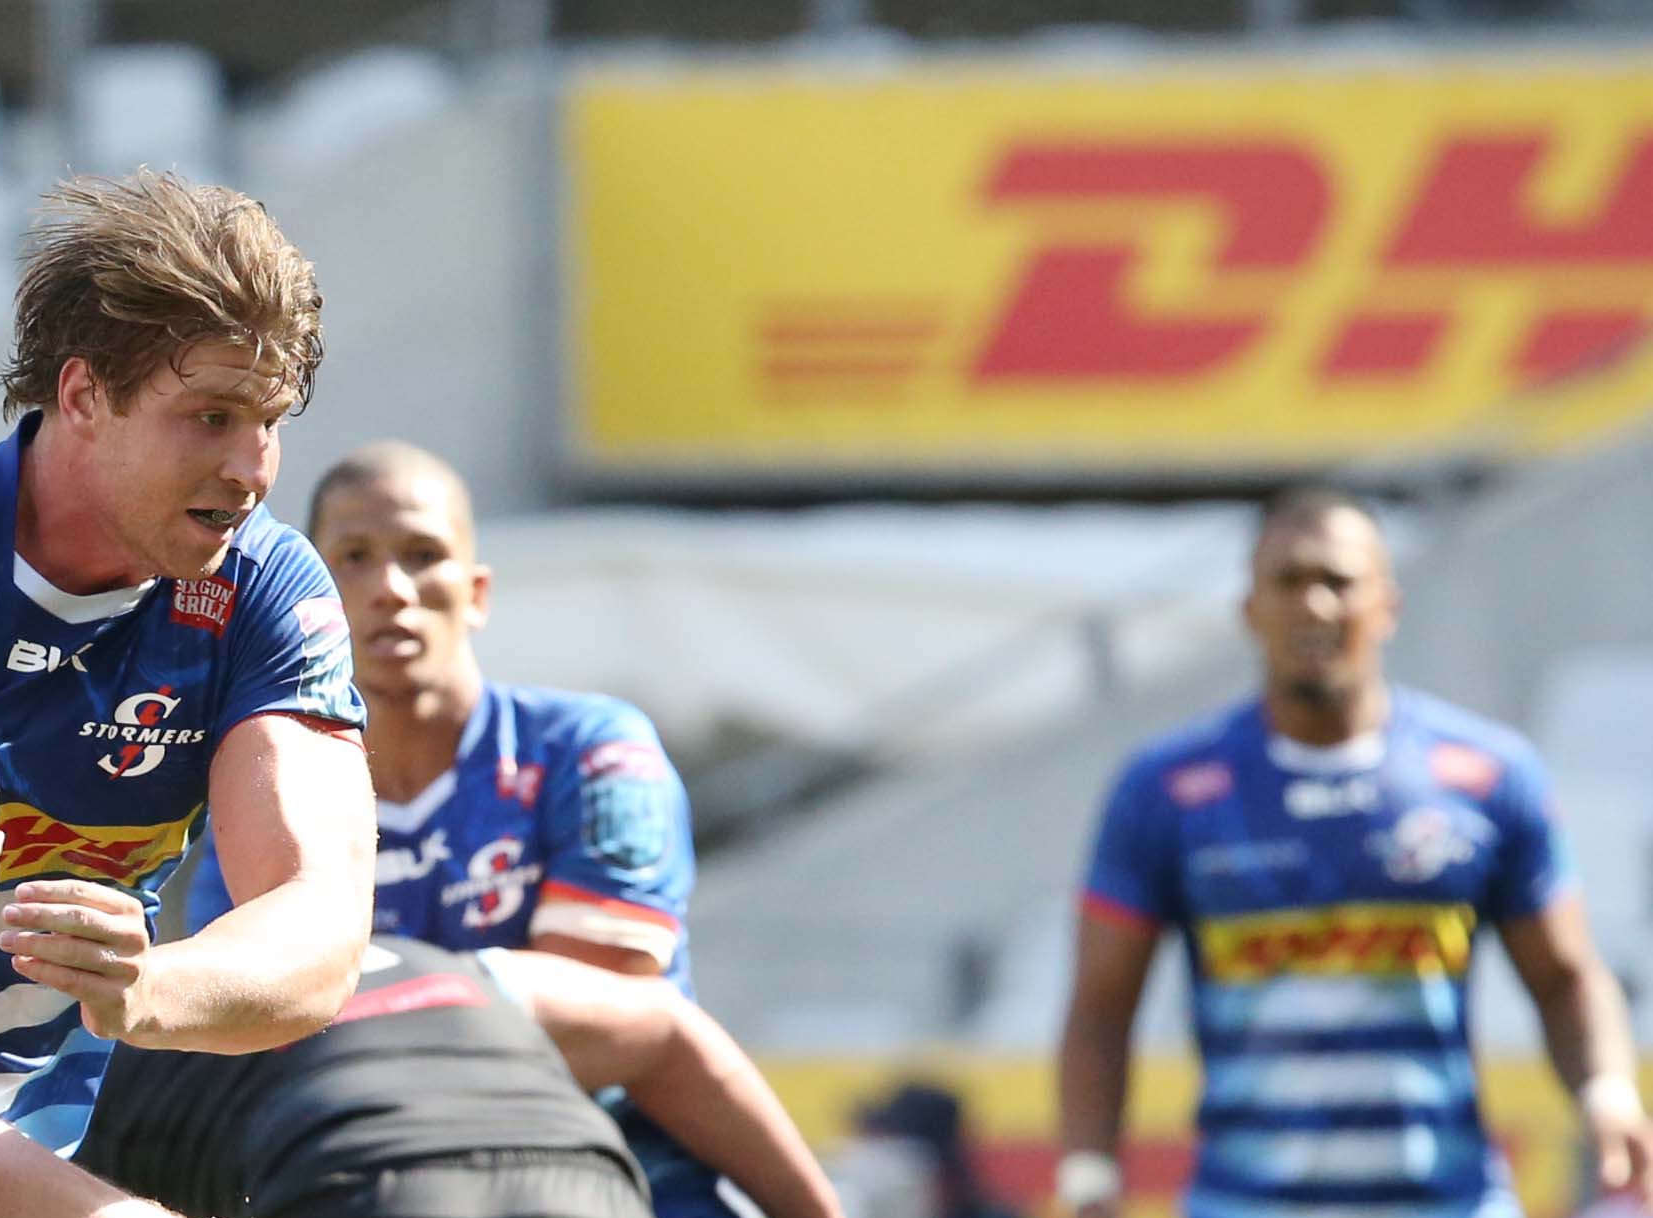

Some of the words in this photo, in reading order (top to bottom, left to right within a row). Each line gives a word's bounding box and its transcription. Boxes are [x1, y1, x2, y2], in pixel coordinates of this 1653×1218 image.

[200, 580, 233, 604] GUN
[174, 592, 226, 625] GRILL
[79, 722, 206, 744] STORMERS
